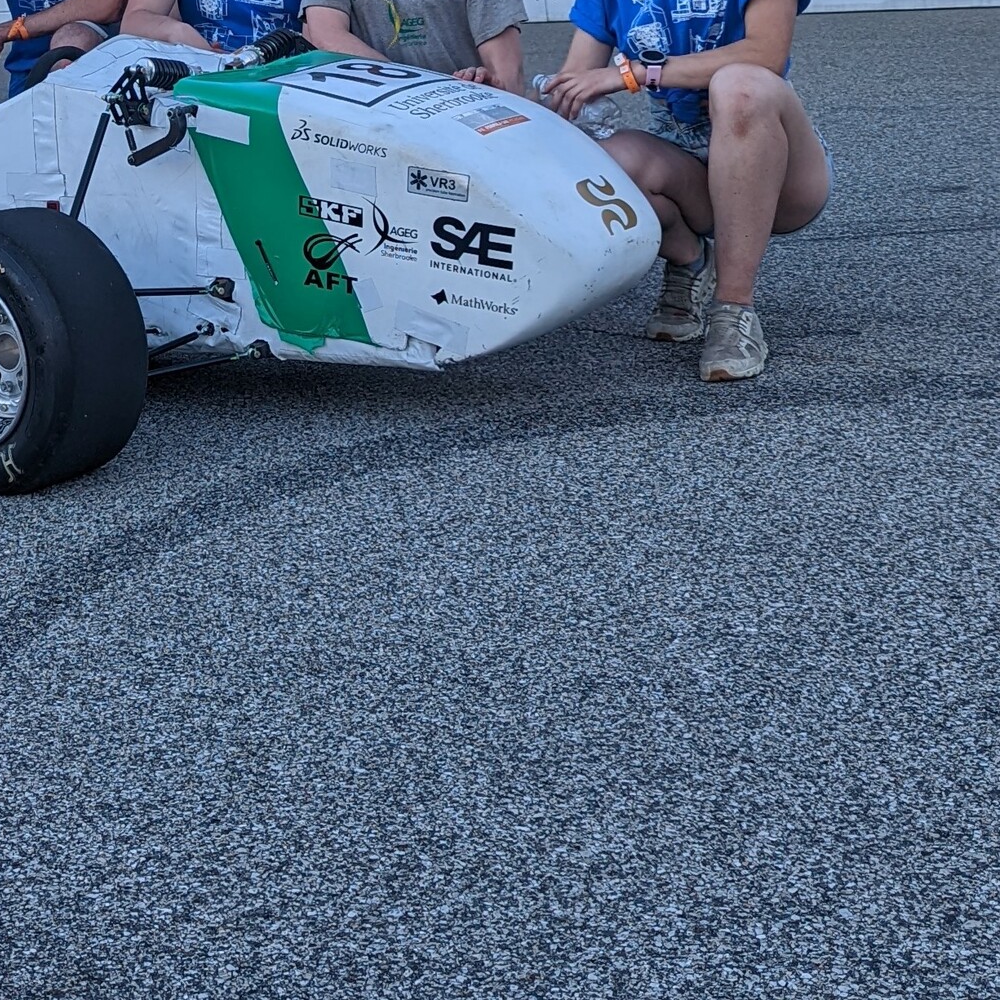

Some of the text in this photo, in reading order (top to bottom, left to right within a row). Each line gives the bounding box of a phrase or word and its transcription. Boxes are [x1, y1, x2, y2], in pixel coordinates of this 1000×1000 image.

[409, 90, 499, 120] Sherbrooke
[313, 132, 389, 159] SOLIDWORKS
[430, 176, 456, 190] VR3
[301, 198, 362, 226] SKF
[390, 226, 419, 239] AGEG
[430, 216, 516, 270] SAE
[304, 269, 358, 294] AFT
[451, 293, 517, 316] MathWorks
